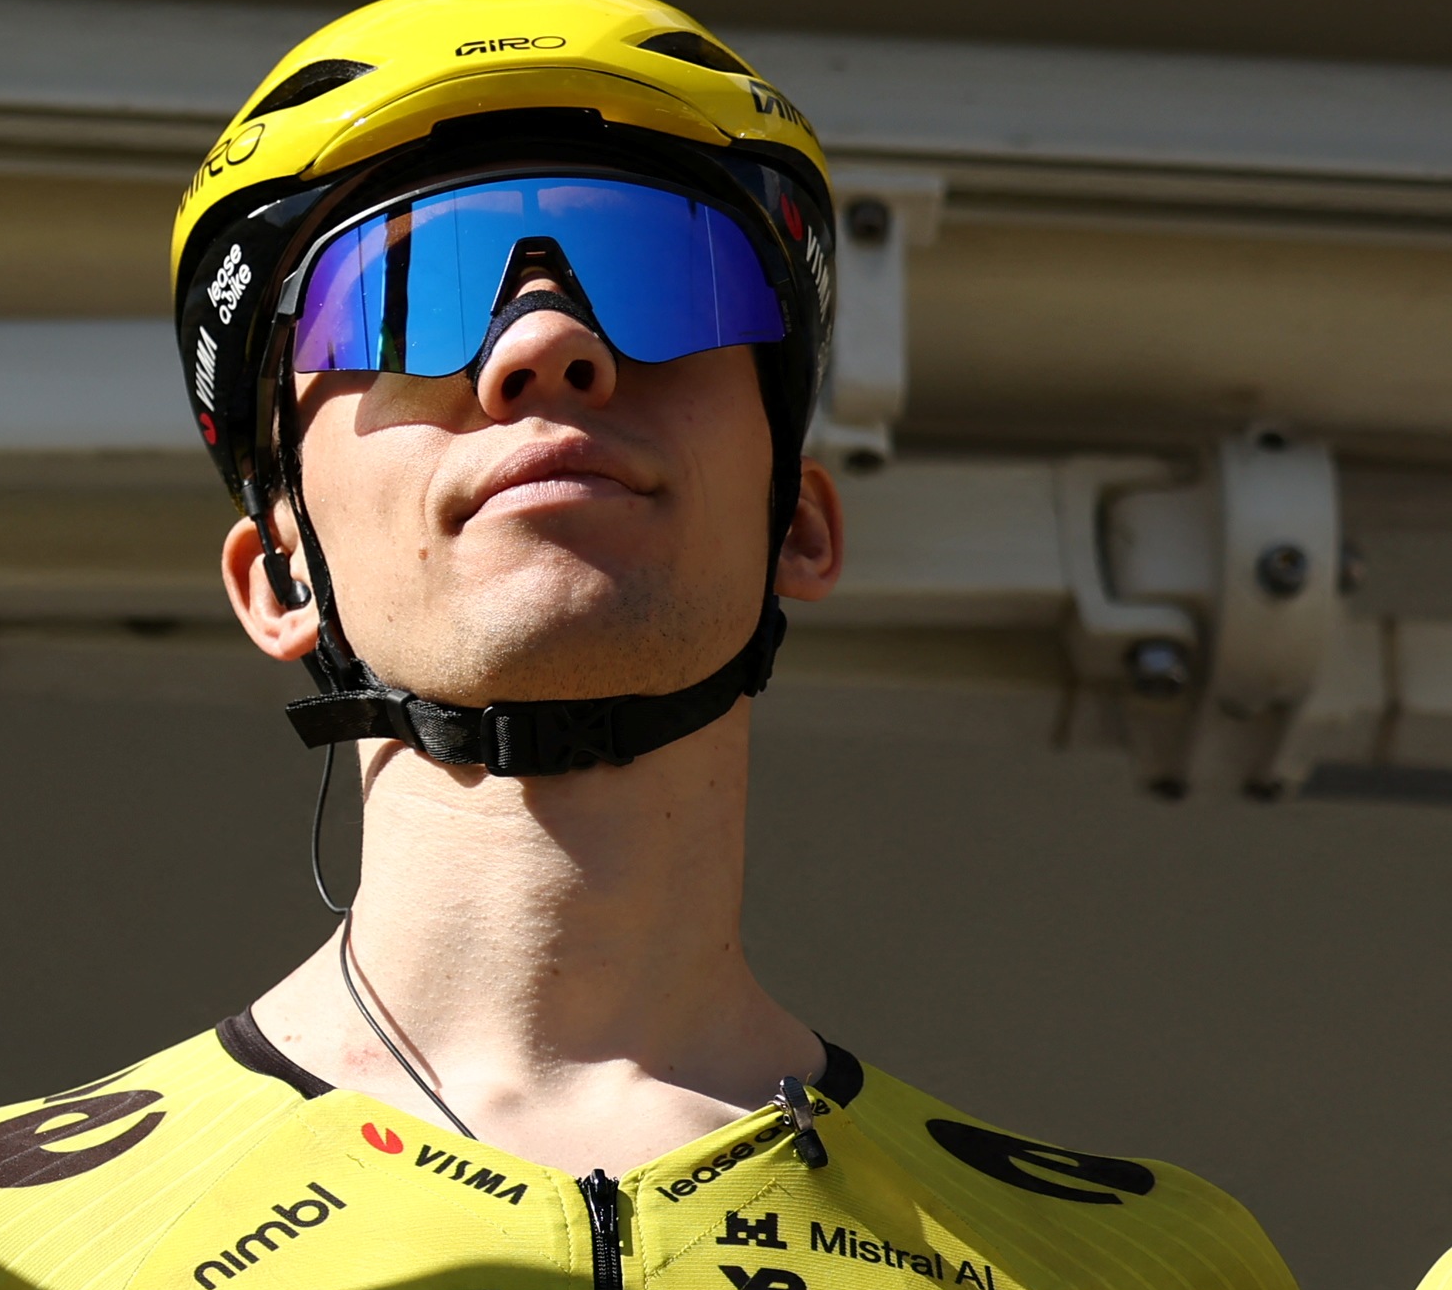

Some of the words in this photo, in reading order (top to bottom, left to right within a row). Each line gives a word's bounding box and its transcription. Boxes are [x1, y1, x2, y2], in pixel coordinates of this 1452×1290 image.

[455, 35, 567, 57] GIRO
[415, 1144, 531, 1206] VISMA
[656, 1141, 745, 1203] lease
[811, 1221, 943, 1281] Mistral
